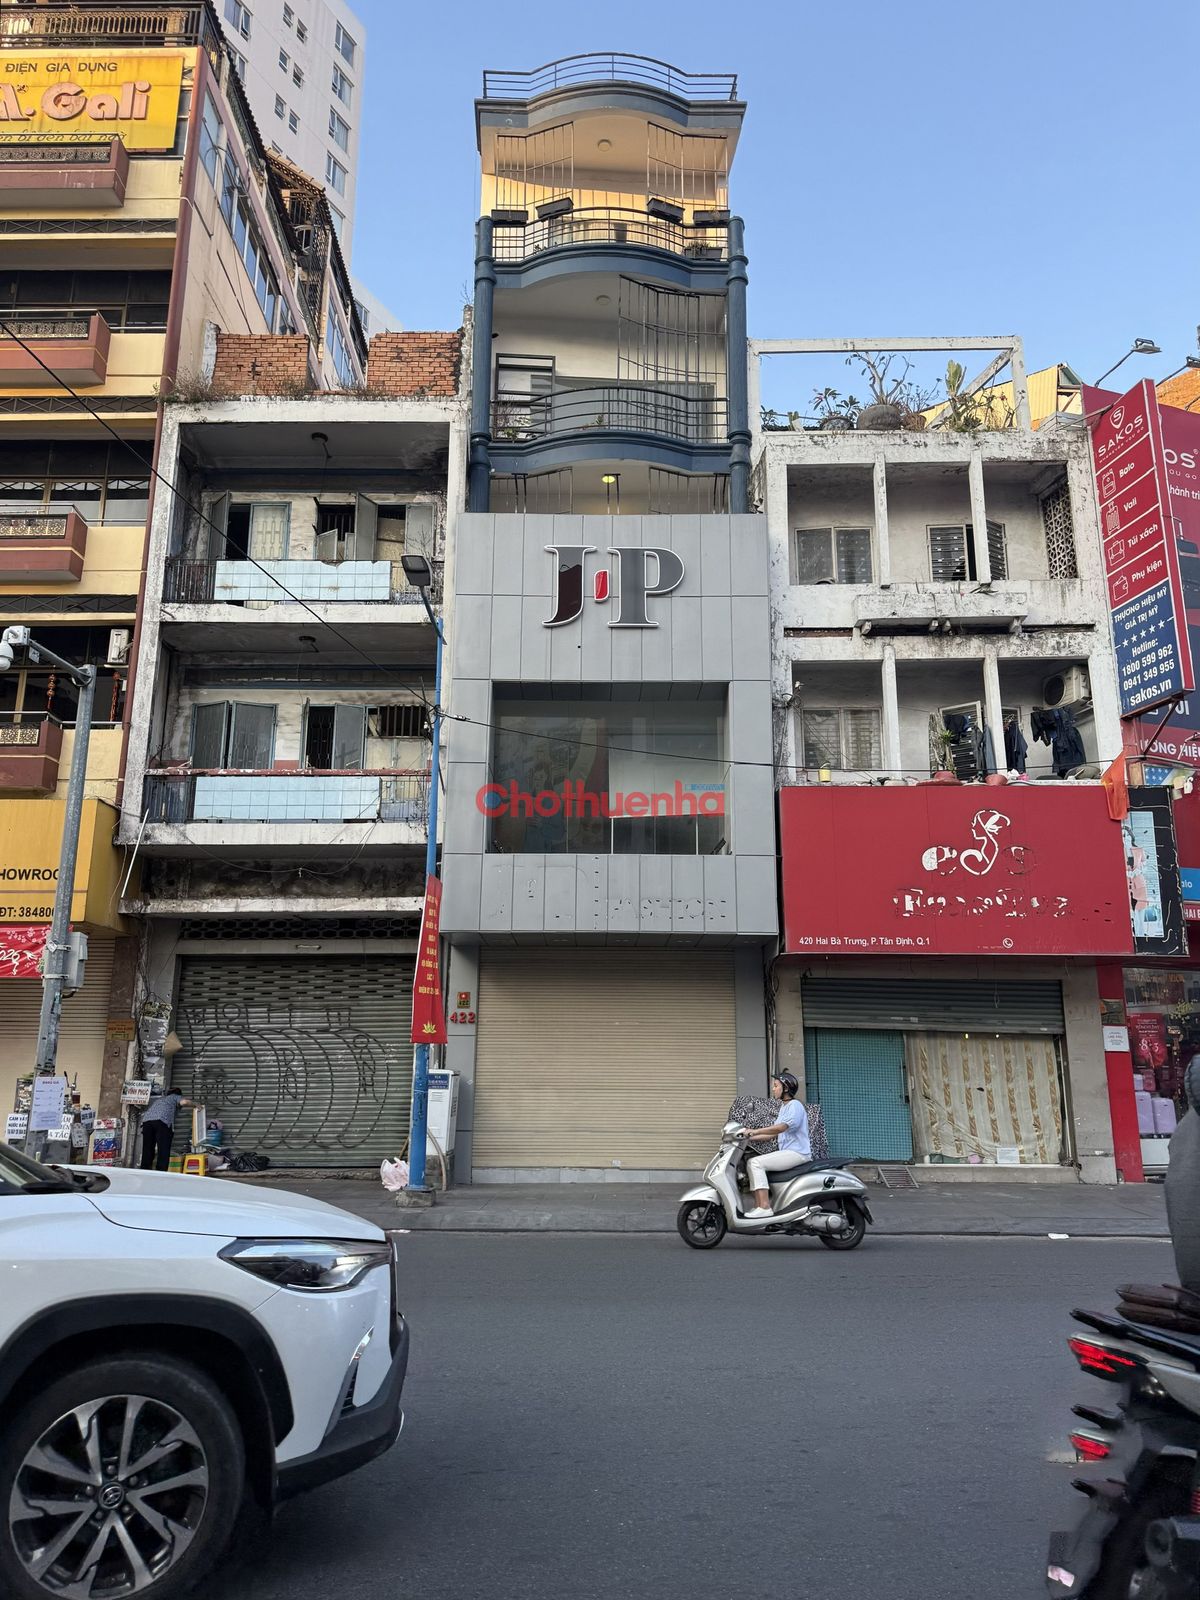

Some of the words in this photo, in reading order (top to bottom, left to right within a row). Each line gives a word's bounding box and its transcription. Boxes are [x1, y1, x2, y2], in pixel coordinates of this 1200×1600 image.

[5, 62, 38, 75] ĐIỆN
[46, 62, 71, 73] GIA
[78, 62, 118, 75] DỤNG
[1098, 414, 1143, 457] SAKOS
[1119, 462, 1135, 479] Balo
[1185, 472, 1197, 480] GO
[1123, 497, 1137, 512] Vali
[1127, 535, 1139, 548] Túi
[1140, 523, 1158, 541] xách
[1131, 570, 1146, 582] Phụ
[1146, 559, 1163, 575] kiện
[1141, 594, 1157, 609] HIỆU
[1156, 586, 1168, 601] MỸ
[1124, 617, 1138, 631] GIÁ
[1148, 604, 1159, 620] MỸ
[1131, 637, 1159, 658] Hotline:
[1122, 661, 1141, 678] 1800
[1141, 652, 1157, 669] 599
[1157, 643, 1173, 660] 962
[1123, 674, 1142, 691] 0941
[1143, 667, 1158, 683] 349
[1159, 658, 1175, 675] 955
[1130, 678, 1172, 707] sakos.vn
[799, 937, 813, 945] 420
[815, 937, 828, 945] Hai
[830, 936, 841, 945] Bà
[843, 937, 869, 947] Trưng,
[896, 937, 915, 947] Định,
[916, 937, 930, 945] Q.1
[450, 1012, 475, 1024] 422
